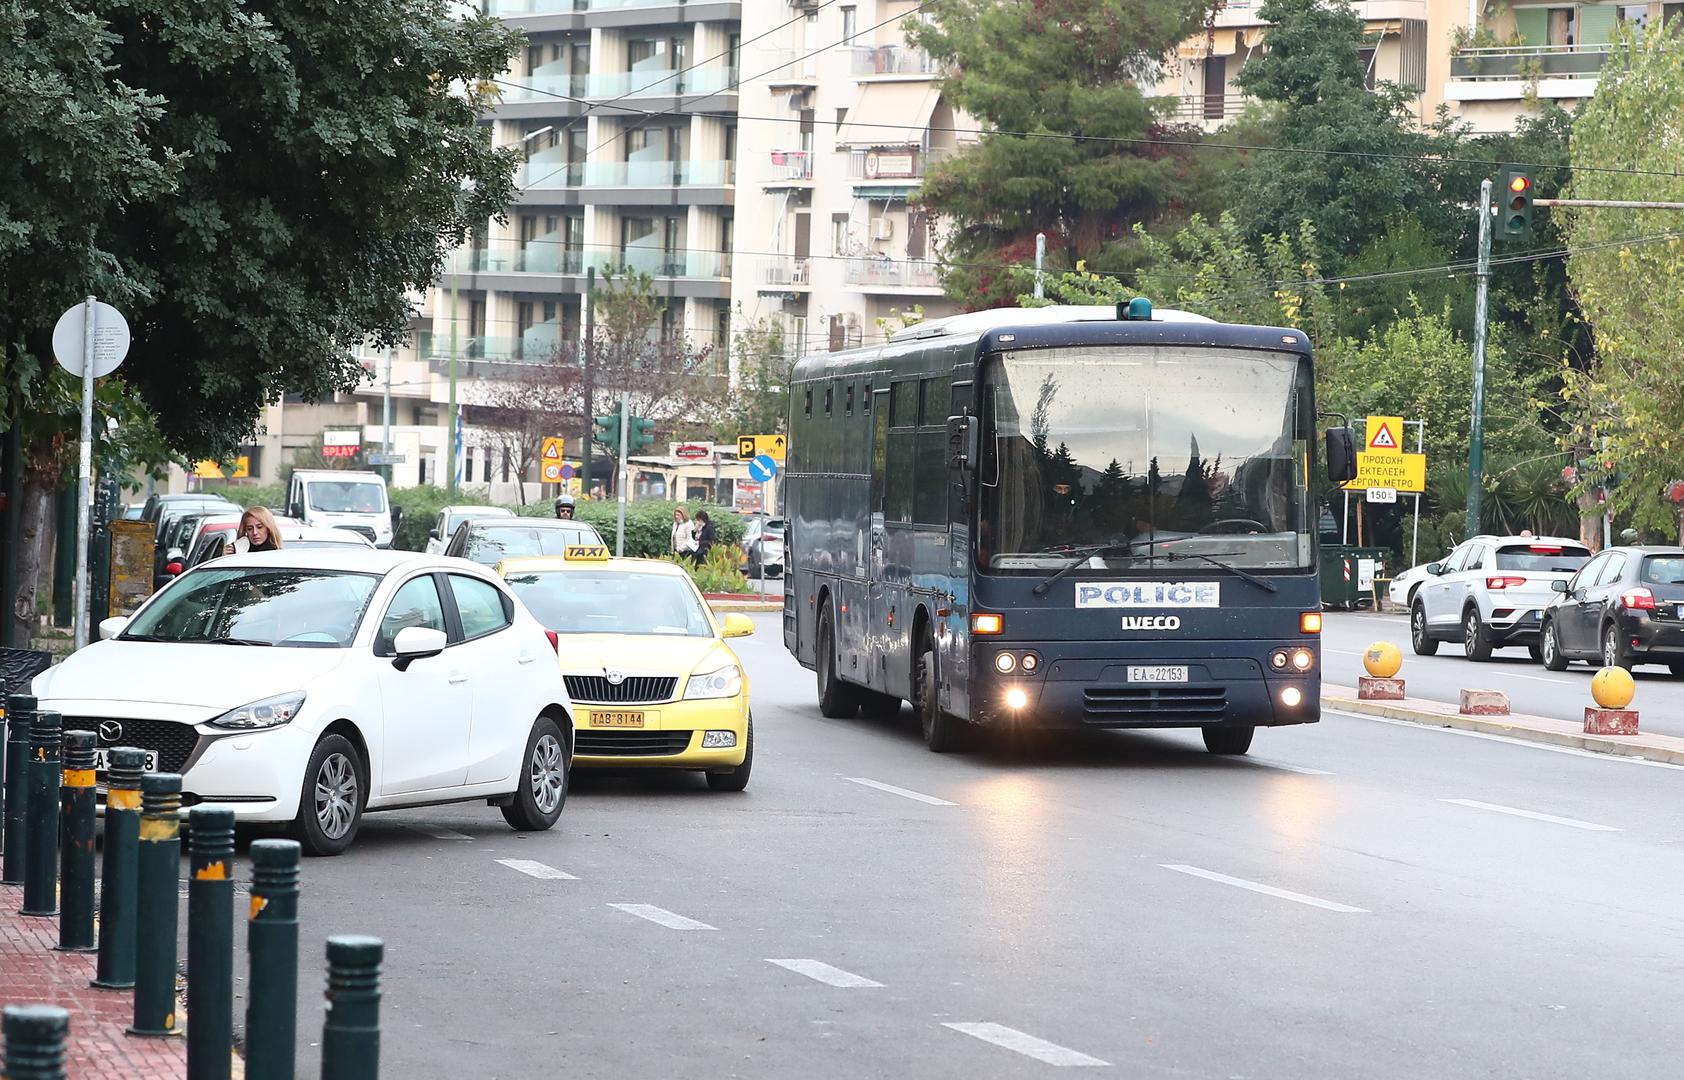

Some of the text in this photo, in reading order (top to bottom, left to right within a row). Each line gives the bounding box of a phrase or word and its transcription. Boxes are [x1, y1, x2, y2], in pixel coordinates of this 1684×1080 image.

[741, 441, 754, 455] P
[1363, 455, 1403, 465] ΠΡΟΣΟΧΗ
[1359, 466, 1406, 477] ΕΚΤΕΛΕΣΗ
[1351, 478, 1413, 488] ΕΡΓΩΝ ΜΕΤΡΟ
[1371, 491, 1387, 500] 150
[568, 547, 605, 557] TAXI
[1079, 585, 1217, 605] POLICE
[1121, 615, 1181, 630] IVECO
[1155, 668, 1183, 681] 22153
